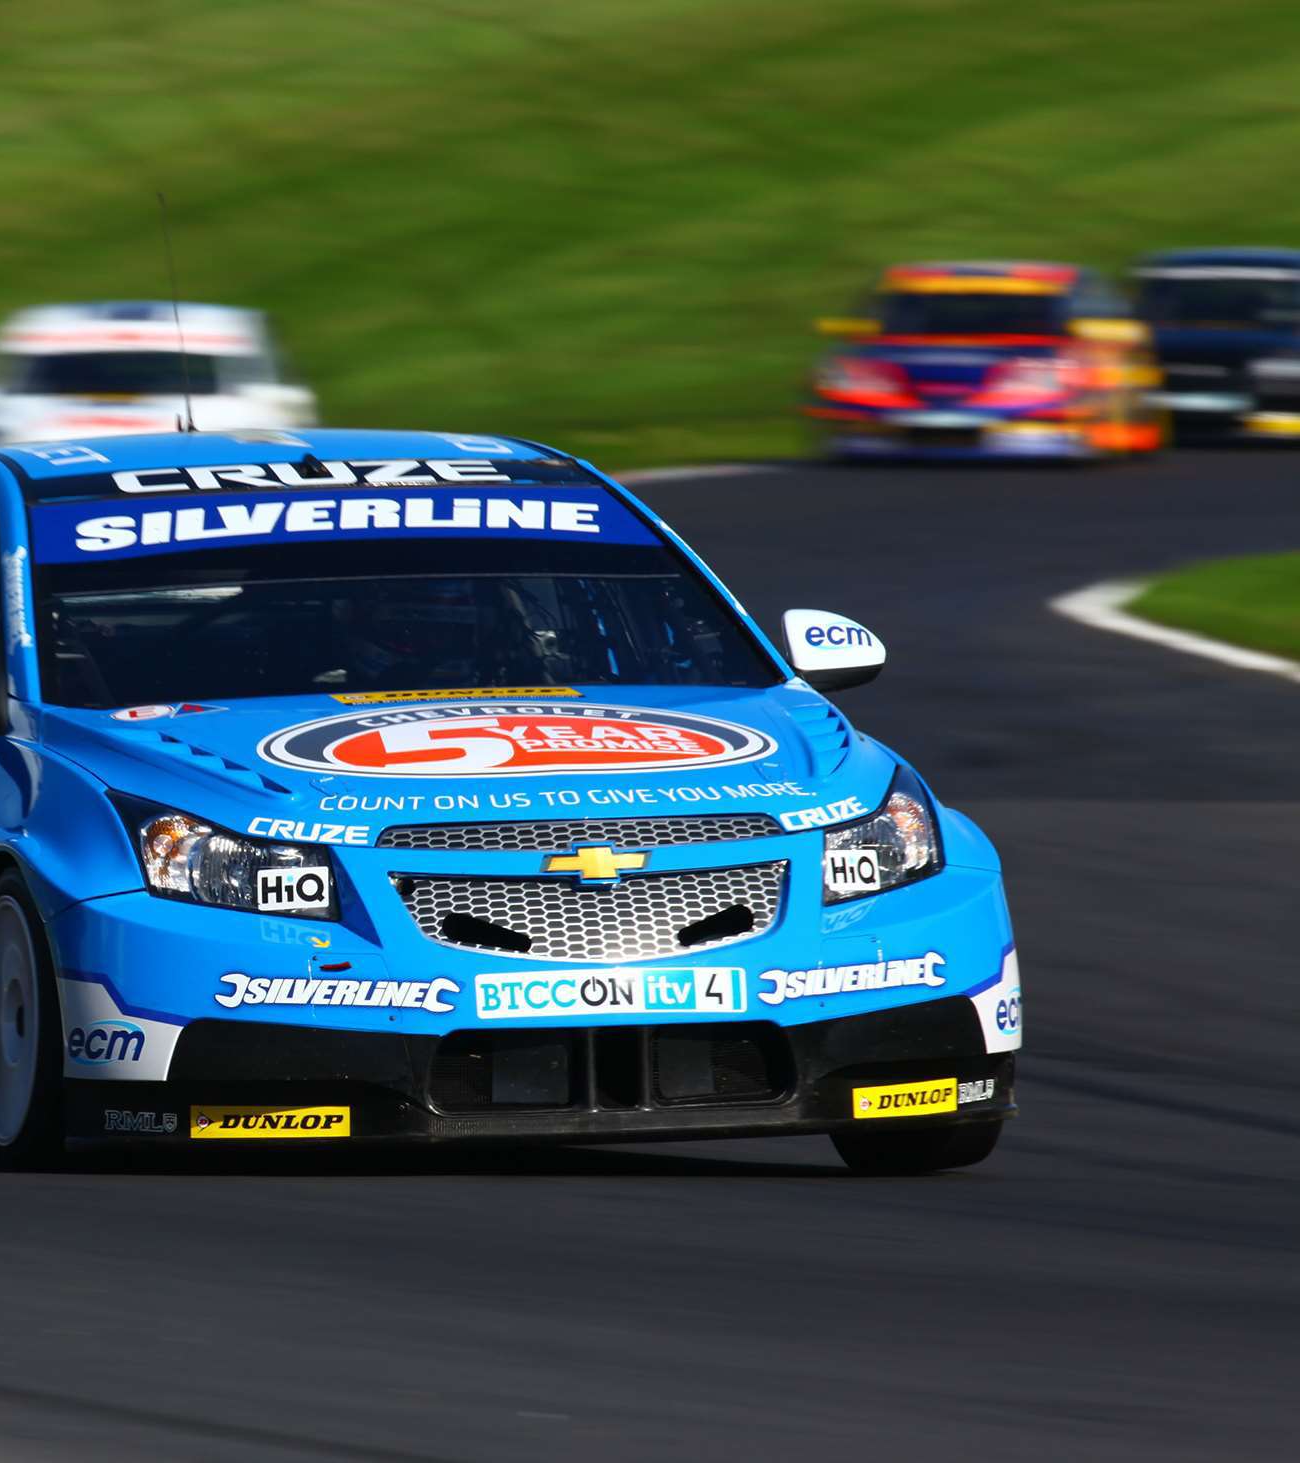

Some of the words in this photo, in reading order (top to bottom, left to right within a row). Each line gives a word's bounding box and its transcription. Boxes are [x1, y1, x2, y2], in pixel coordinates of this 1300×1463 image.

[111, 458, 512, 493] CRUZE
[805, 626, 872, 647] ecm
[356, 706, 641, 728] CHEVROLET
[376, 718, 515, 769] 5
[484, 725, 694, 742] YEAR
[515, 738, 708, 754] PROMISE
[319, 794, 426, 811] COUNT
[434, 795, 480, 810] ON
[490, 792, 532, 808] US
[539, 790, 580, 806] TO
[587, 789, 658, 804] GIVE
[658, 786, 722, 802] YOU
[722, 782, 818, 800] MORE.
[779, 796, 870, 832] CRUZE
[247, 816, 371, 845] CRUZE
[831, 856, 877, 884] HiQ
[261, 873, 325, 904] HiQ
[648, 975, 693, 1005] itv
[705, 973, 723, 1005] 4
[996, 997, 1021, 1030] ec
[68, 1027, 145, 1061] ecm
[877, 1087, 953, 1110] DUNLOP
[104, 1110, 164, 1132] RML
[219, 1114, 344, 1130] DUNLOP
